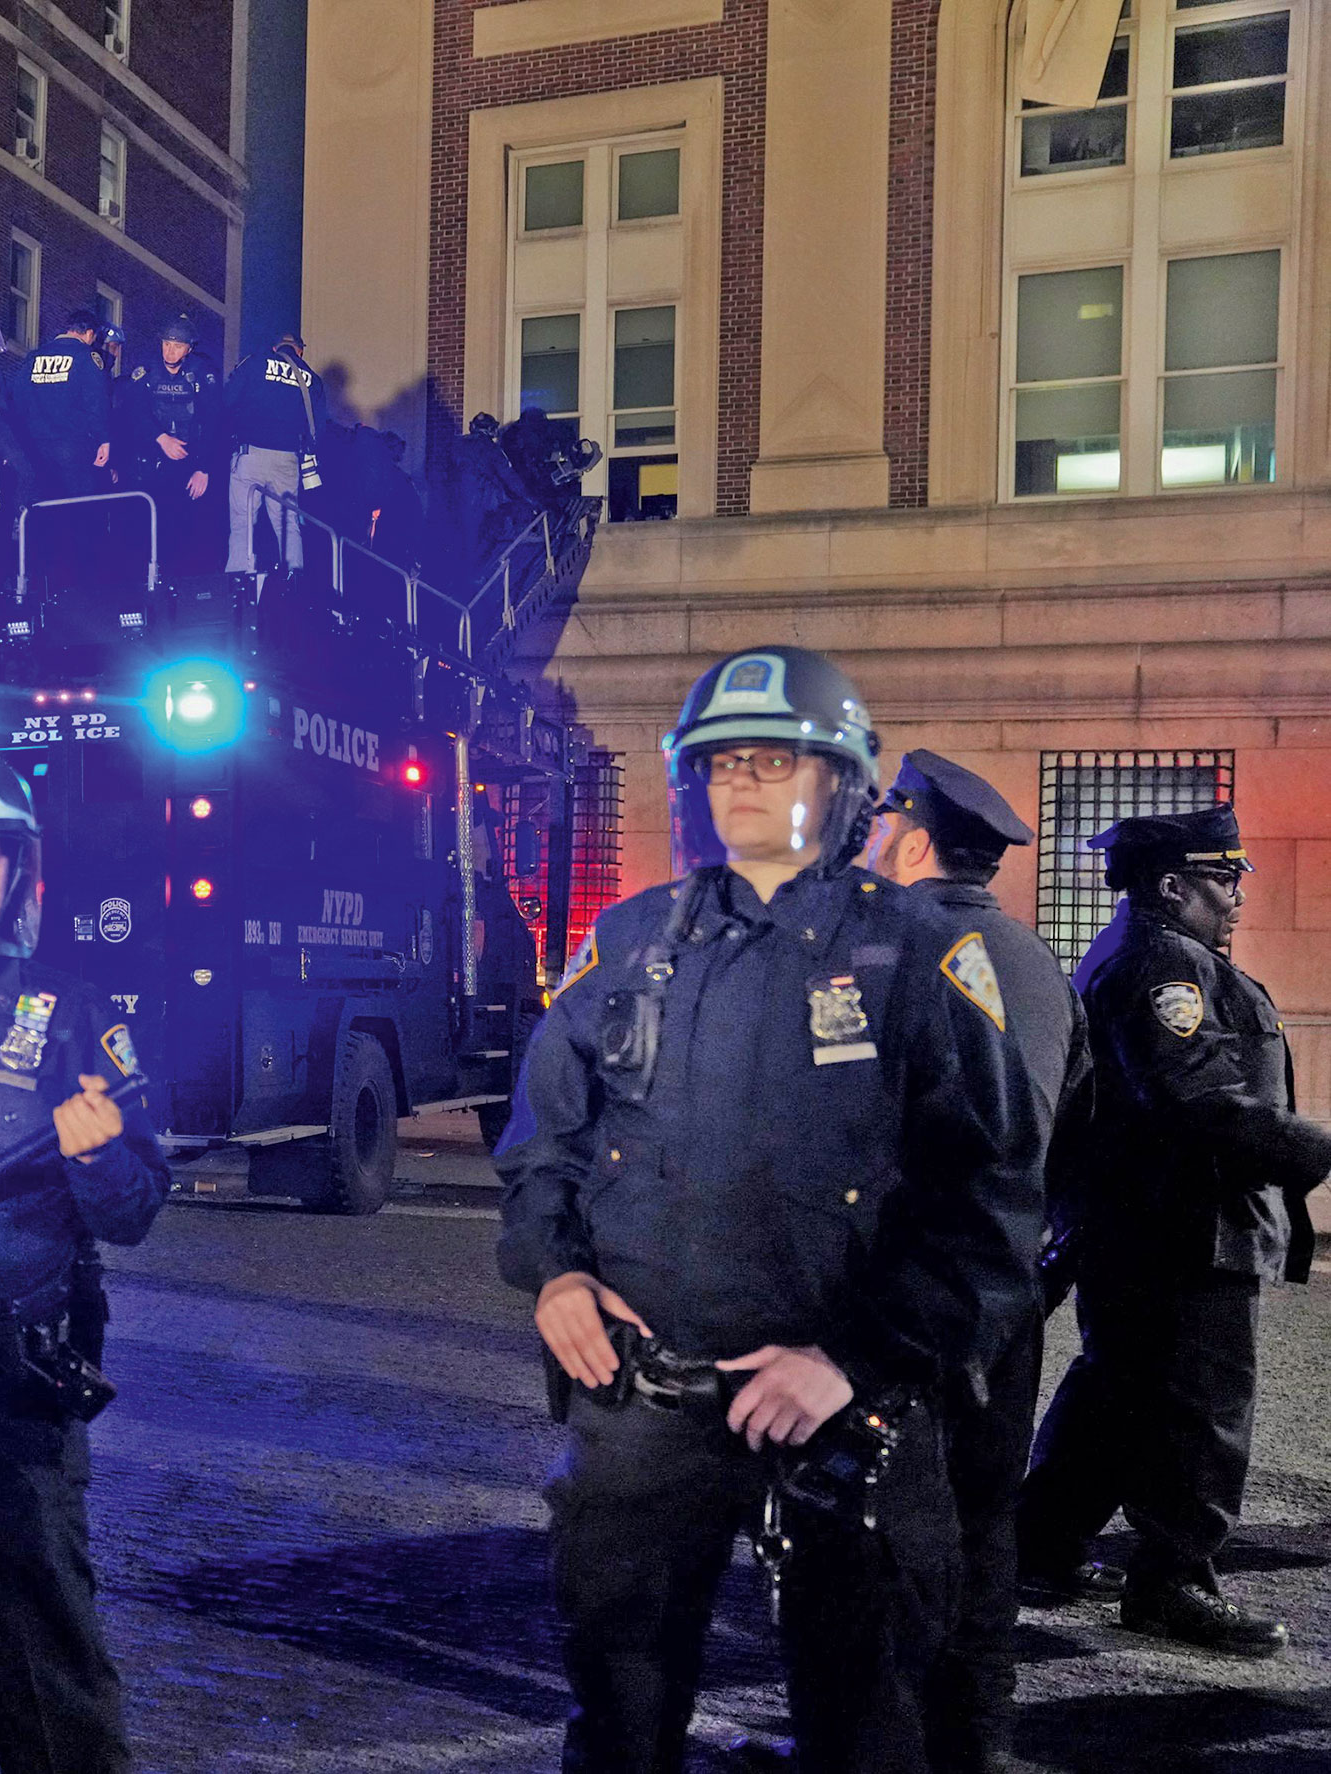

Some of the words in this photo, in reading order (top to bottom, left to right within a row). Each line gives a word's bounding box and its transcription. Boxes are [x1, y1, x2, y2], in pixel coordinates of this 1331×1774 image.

[32, 355, 74, 373] NYPD
[157, 384, 183, 392] POLICE
[24, 715, 61, 729] NY
[71, 713, 107, 726] PD
[11, 729, 63, 744] POL
[74, 726, 121, 740] ICE
[293, 706, 380, 773] POLICE
[102, 900, 129, 912] POLICE
[321, 888, 364, 926] NYPD
[268, 921, 282, 945] ESU
[297, 925, 339, 946] EMERGENCY
[341, 928, 368, 947] SERVICE
[369, 930, 384, 948] UNIT
